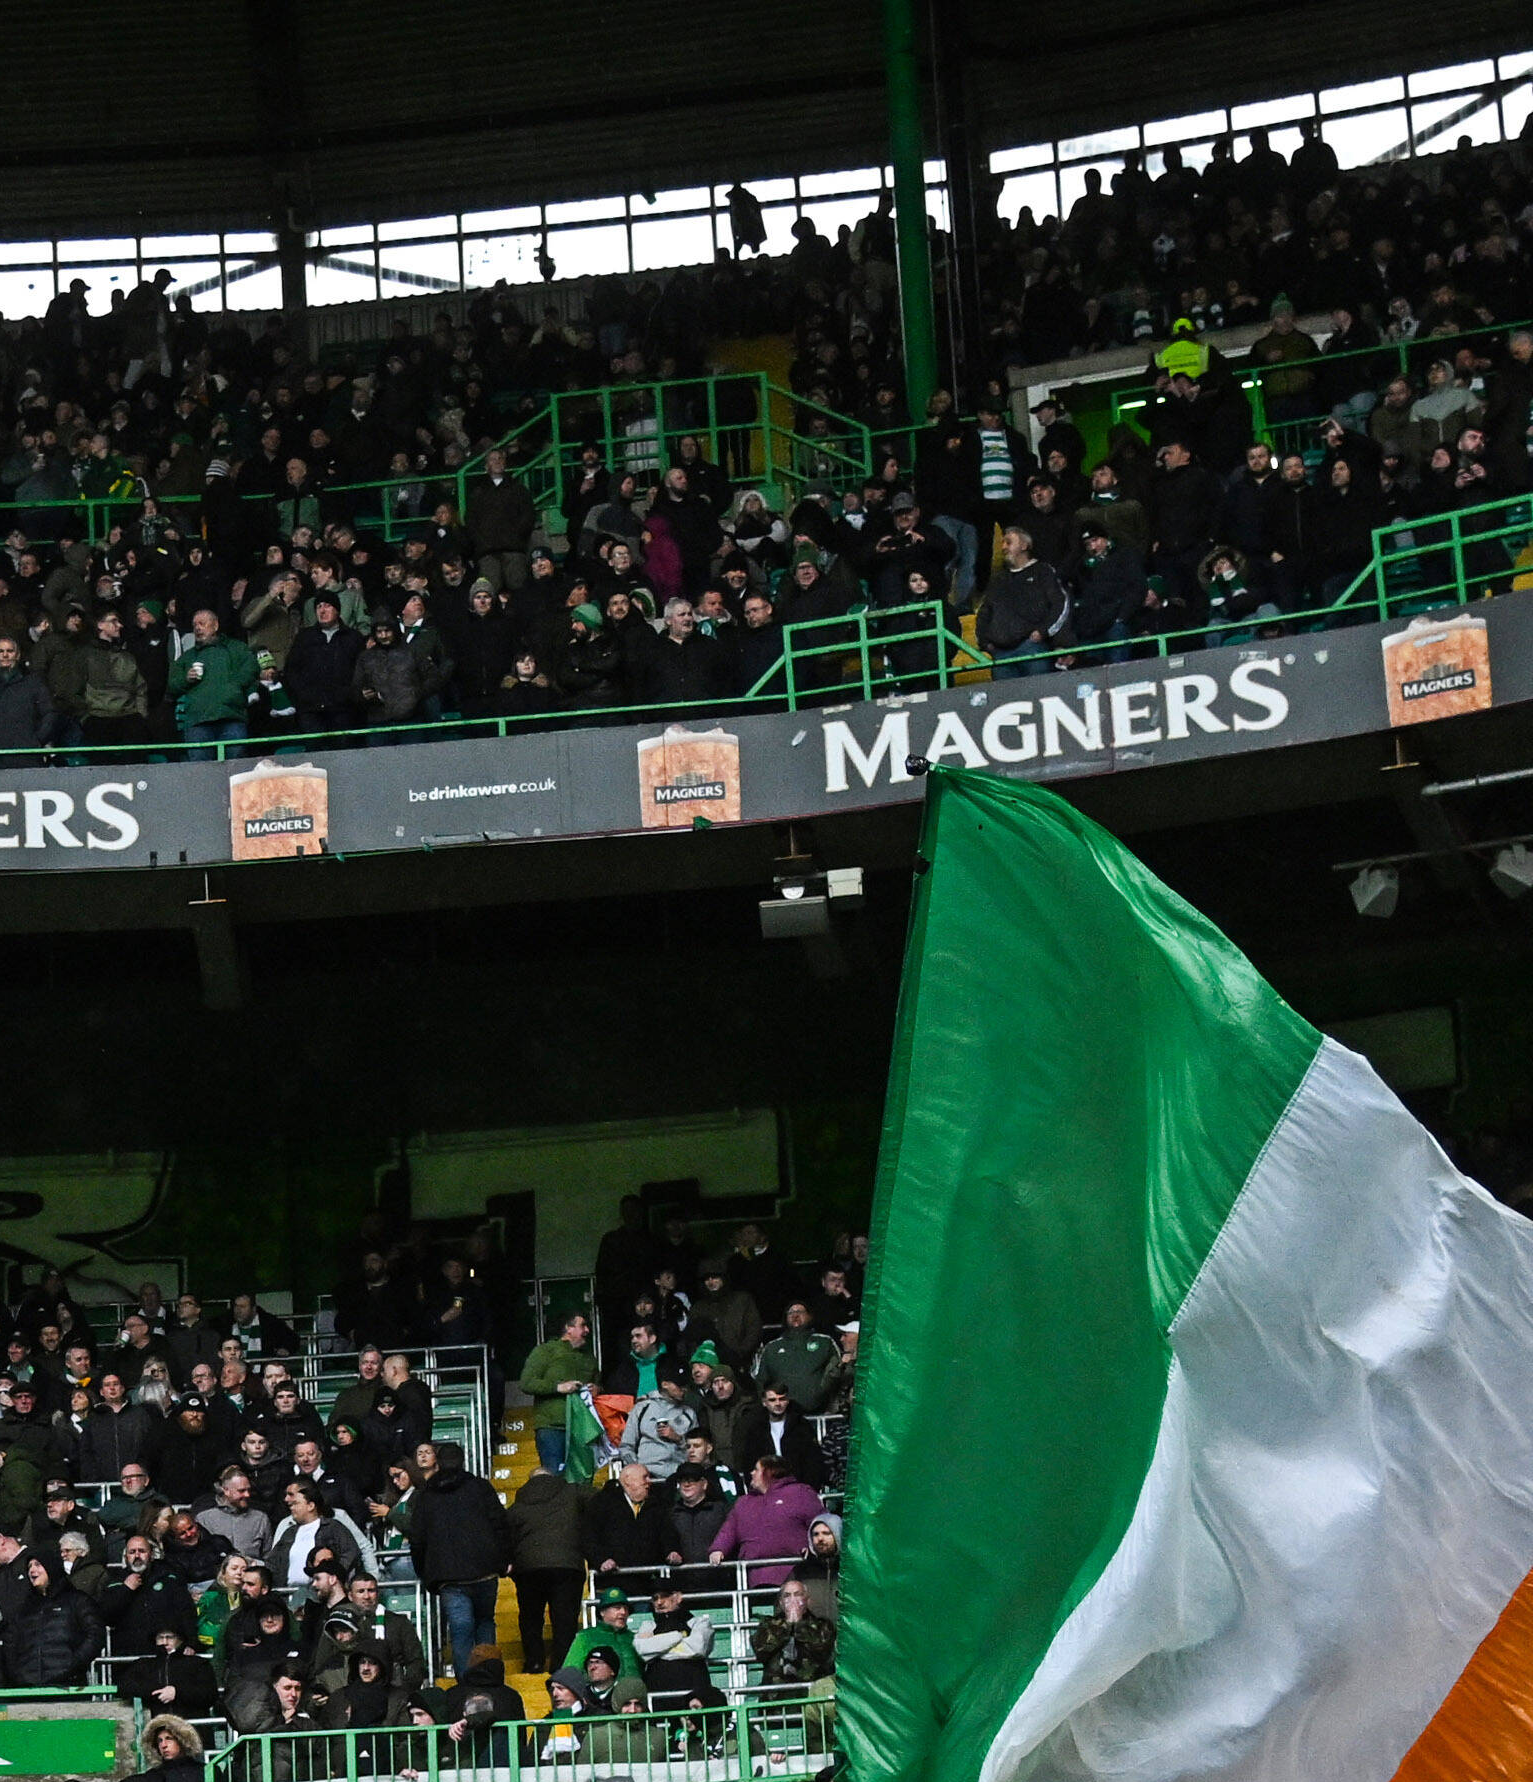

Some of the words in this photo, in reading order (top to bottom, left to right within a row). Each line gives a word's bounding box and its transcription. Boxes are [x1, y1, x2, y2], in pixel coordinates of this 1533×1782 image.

[1403, 673, 1472, 699] MAGNERS
[824, 656, 1291, 793] MAGNERS
[408, 776, 557, 803] bedrinkaware.co.uk
[656, 785, 723, 801] MAGNERS
[246, 819, 312, 835] MAGNERS
